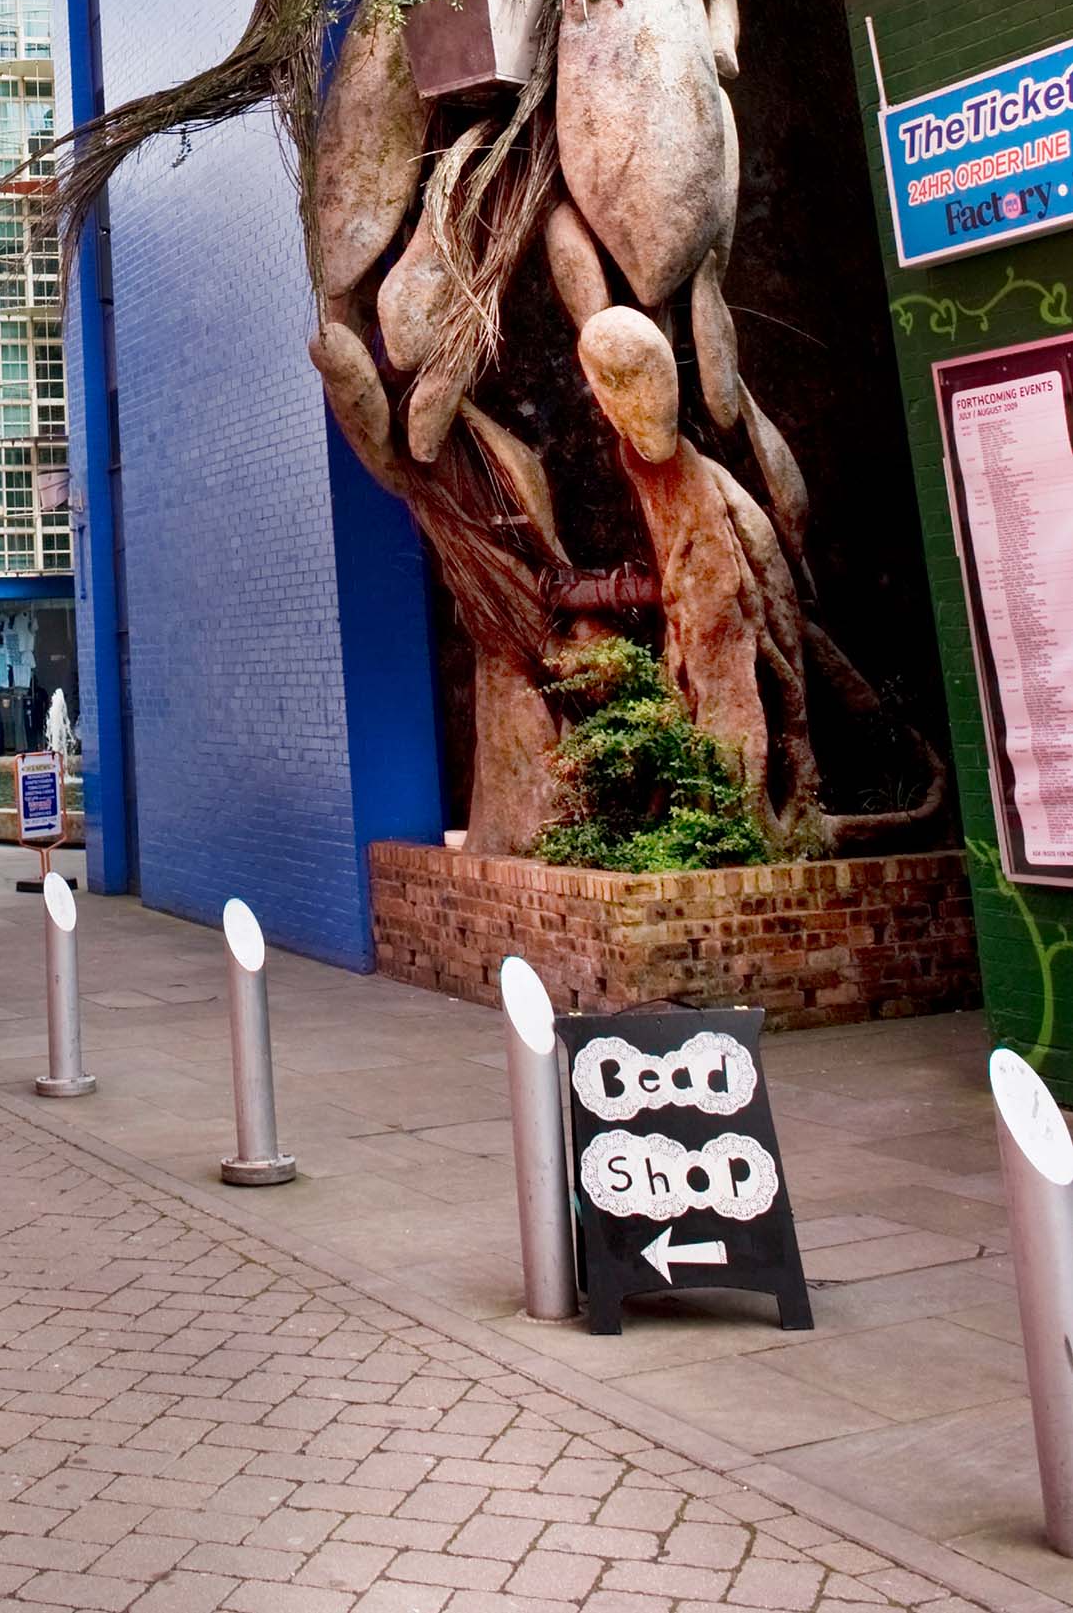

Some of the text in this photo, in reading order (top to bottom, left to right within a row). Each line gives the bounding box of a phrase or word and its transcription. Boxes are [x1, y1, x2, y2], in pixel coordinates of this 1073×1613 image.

[909, 133, 1069, 203] 24HR ORDER LINE
[956, 380, 1053, 410] FORTHCOMING EVENTS
[977, 405, 1002, 417] AUGUST
[599, 1054, 730, 1098] Bead
